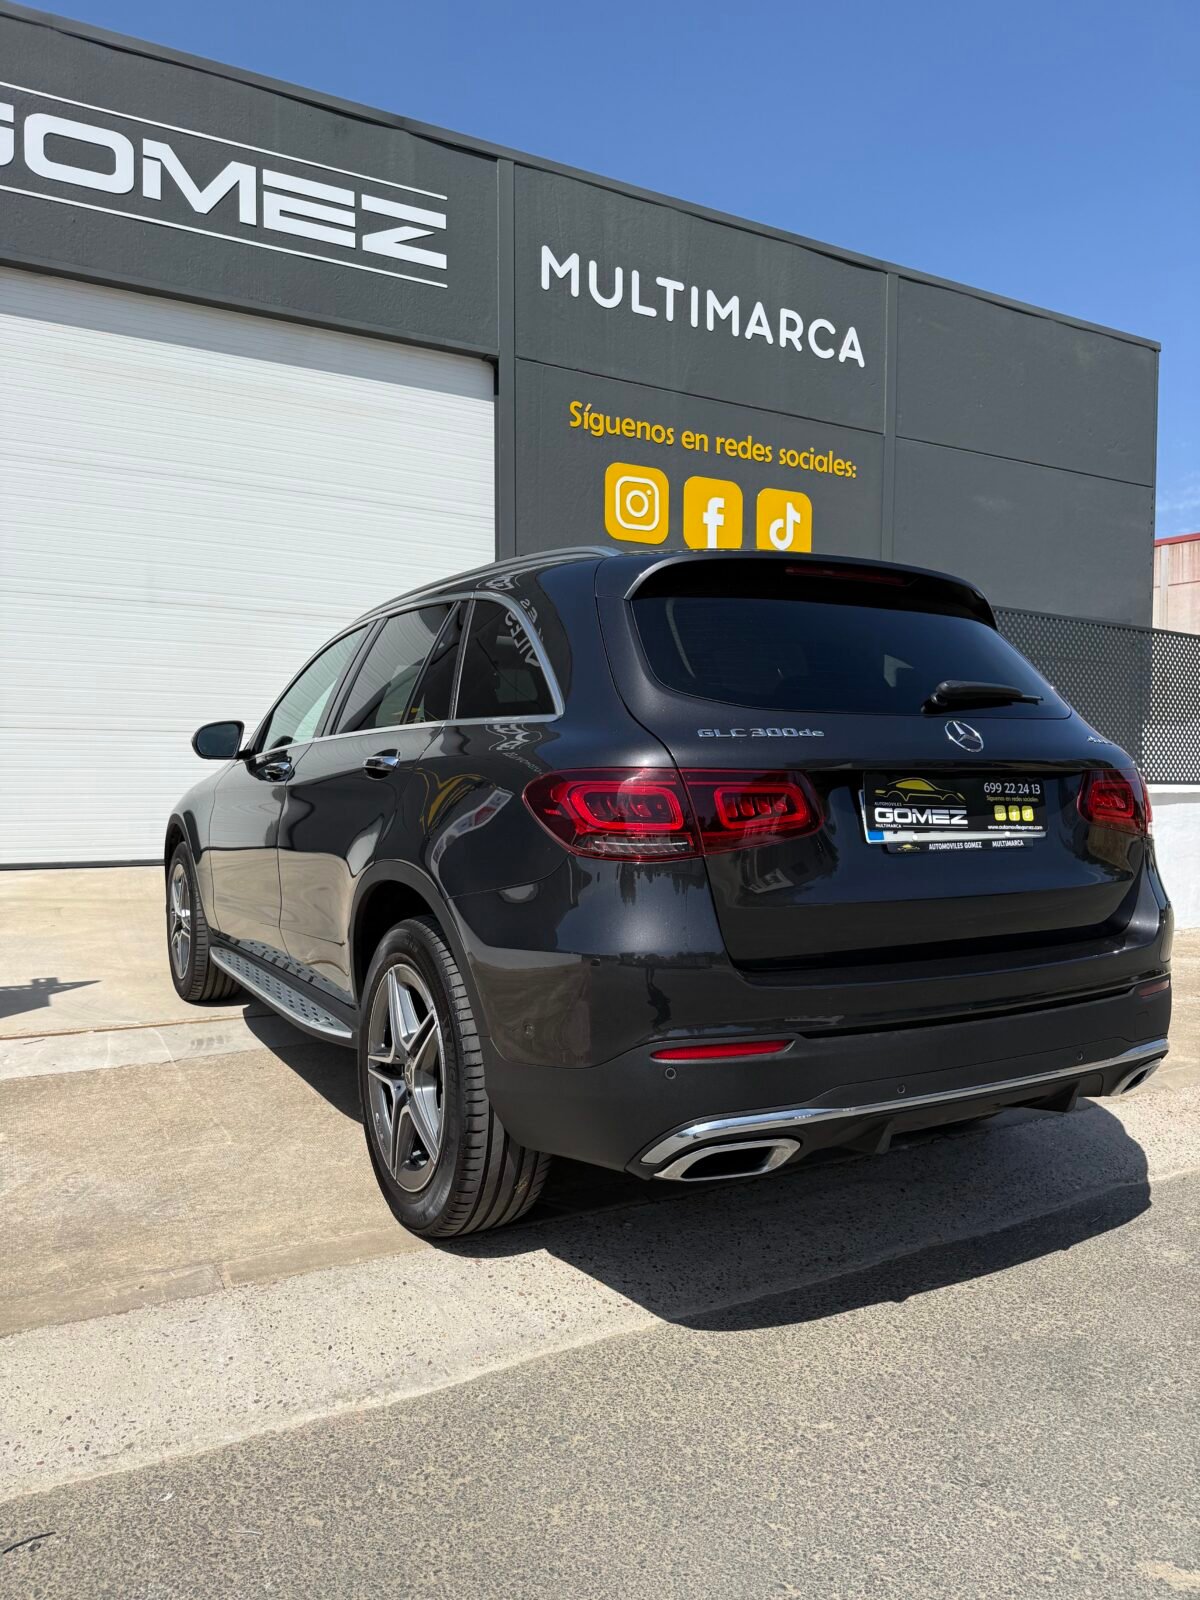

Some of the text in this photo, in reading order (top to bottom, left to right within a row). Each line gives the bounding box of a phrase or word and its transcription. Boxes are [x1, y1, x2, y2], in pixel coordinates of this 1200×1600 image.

[0, 102, 448, 270] OMEZ
[540, 245, 866, 368] MULTIMARCA
[568, 400, 858, 478] Síguenos en redes sociales:
[697, 727, 825, 737] GLC 300de
[983, 783, 1041, 794] 699 22 24 13
[874, 808, 968, 824] GOMEZ
[928, 840, 1025, 850] AUTOMOVILES GOMEZ MULTIMARCA
